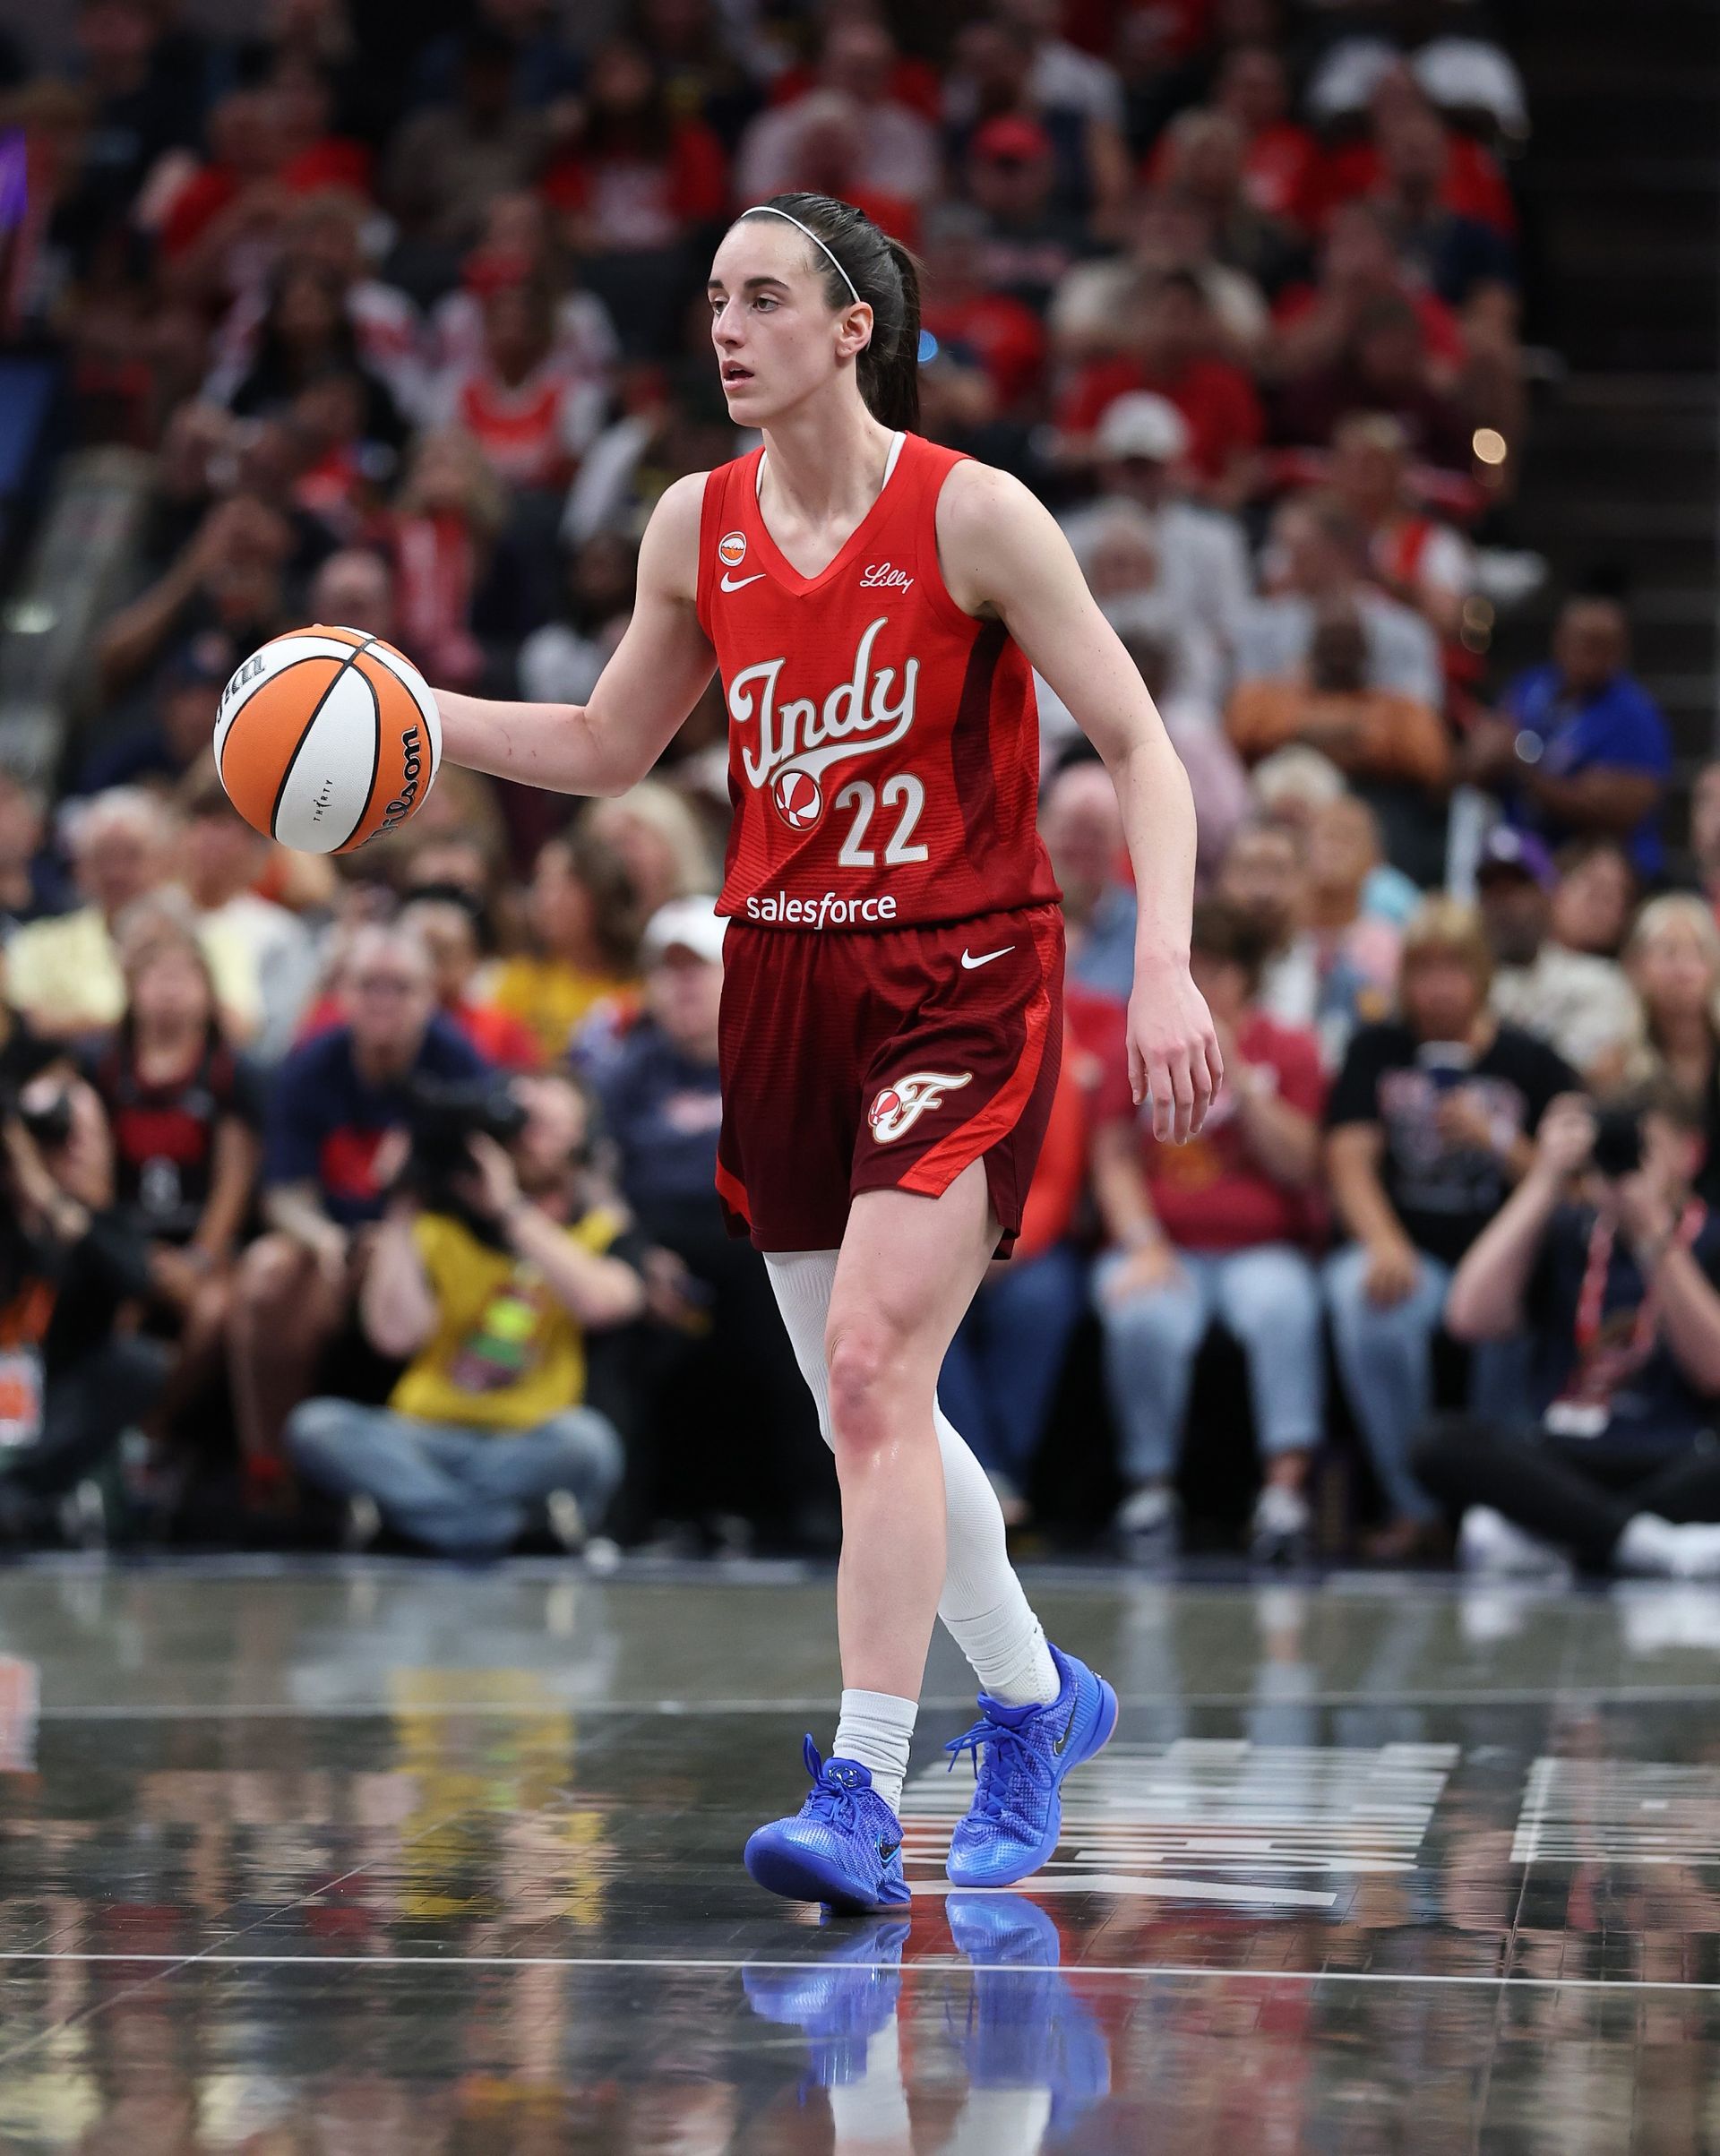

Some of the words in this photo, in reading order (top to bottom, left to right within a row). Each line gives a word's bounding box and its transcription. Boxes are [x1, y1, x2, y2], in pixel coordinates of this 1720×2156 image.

[859, 563, 914, 594] Lilly
[729, 616, 920, 788] Indy
[835, 772, 929, 868] 22
[746, 890, 897, 930] salesforce
